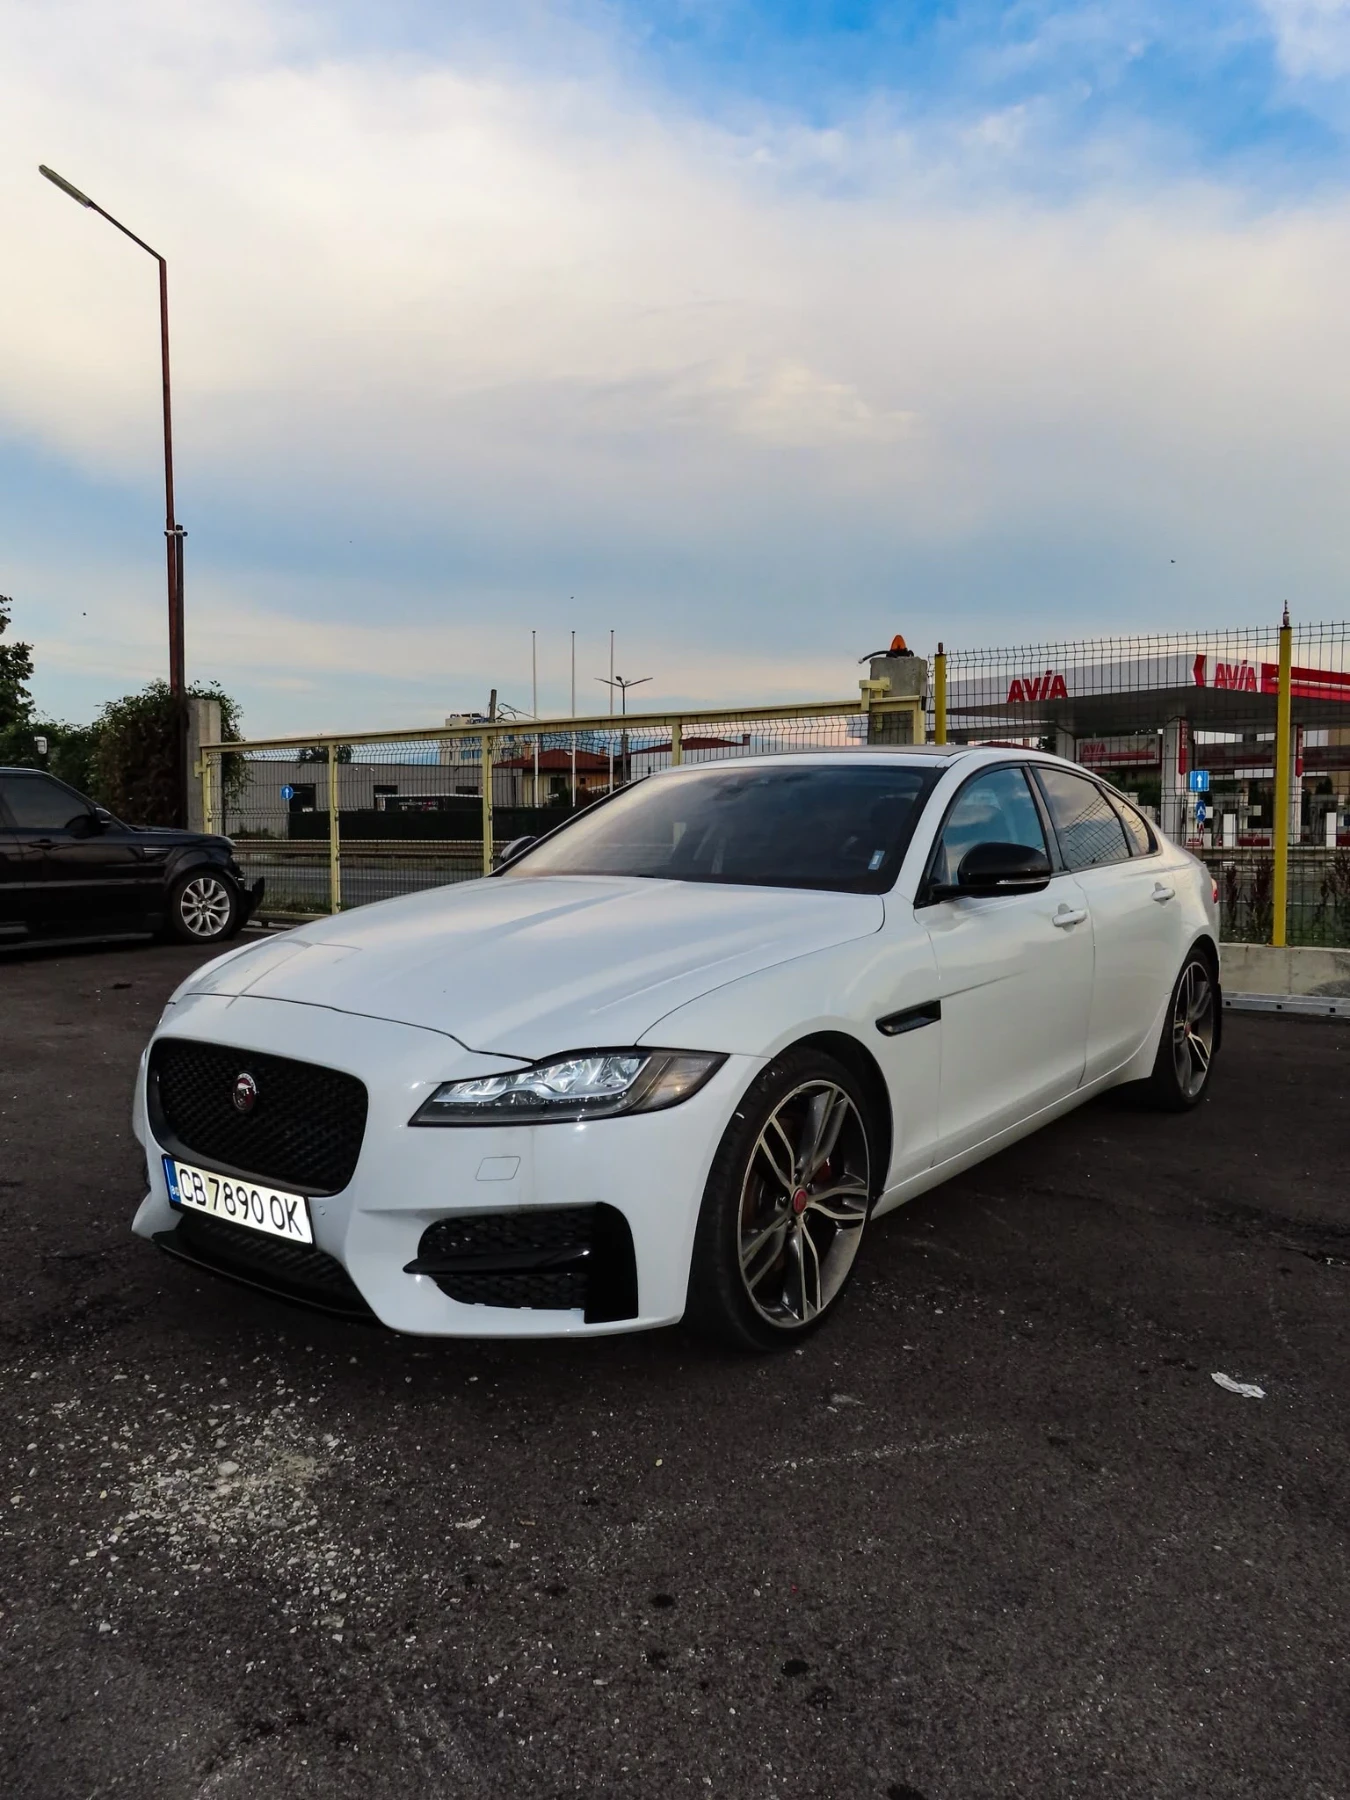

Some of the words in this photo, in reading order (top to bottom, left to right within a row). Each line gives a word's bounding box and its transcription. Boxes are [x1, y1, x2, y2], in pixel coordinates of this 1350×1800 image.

[180, 1169, 207, 1206] CB
[209, 1178, 263, 1224] 7890
[270, 1195, 303, 1236] OK
